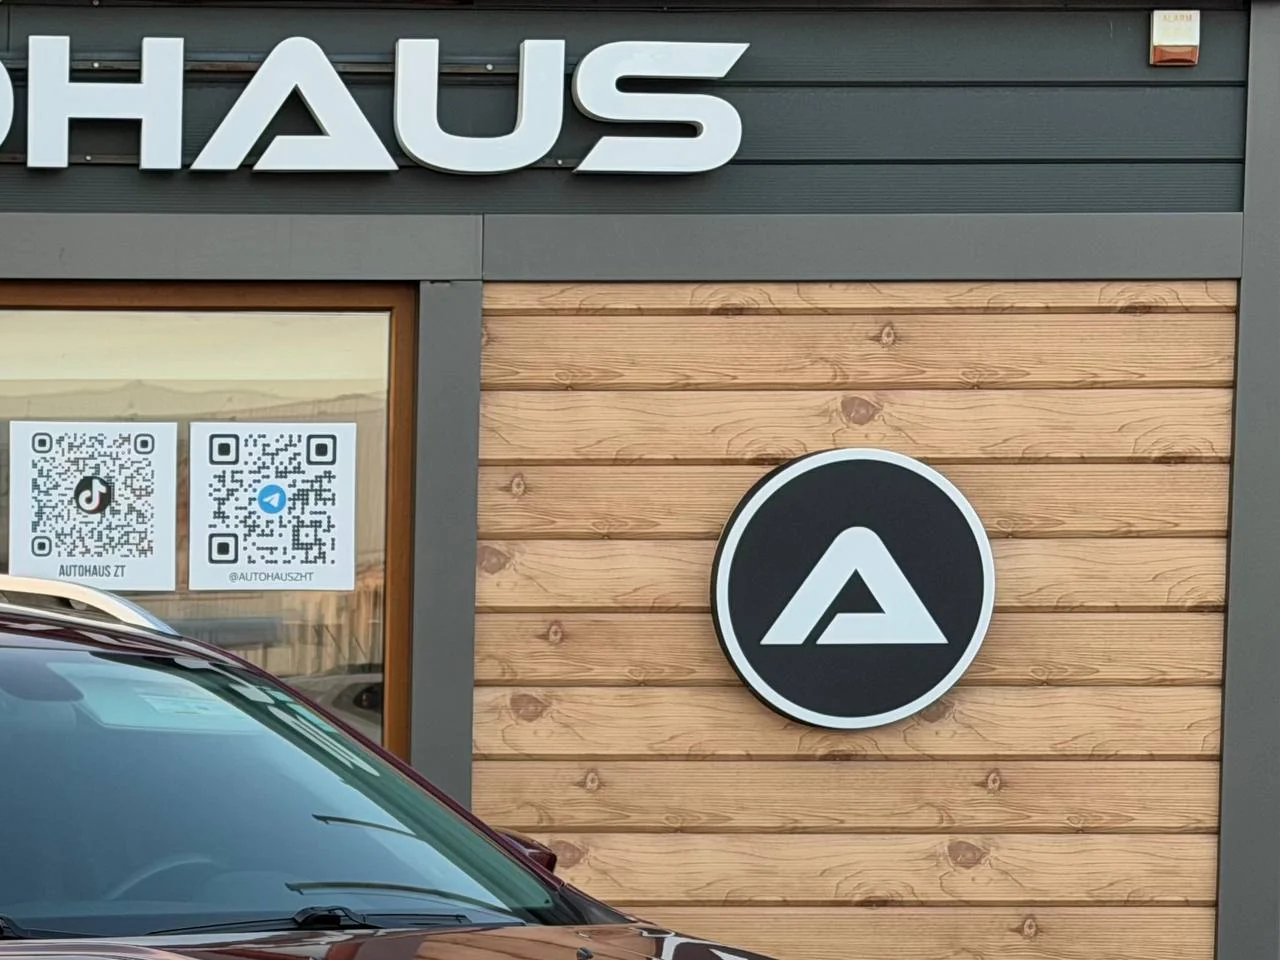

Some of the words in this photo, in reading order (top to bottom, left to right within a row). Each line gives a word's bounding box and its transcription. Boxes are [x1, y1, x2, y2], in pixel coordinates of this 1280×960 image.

[58, 564, 111, 577] AUTOHAUS
[113, 565, 126, 578] ZT
[229, 571, 314, 582] @AUTOHAUSZHT
